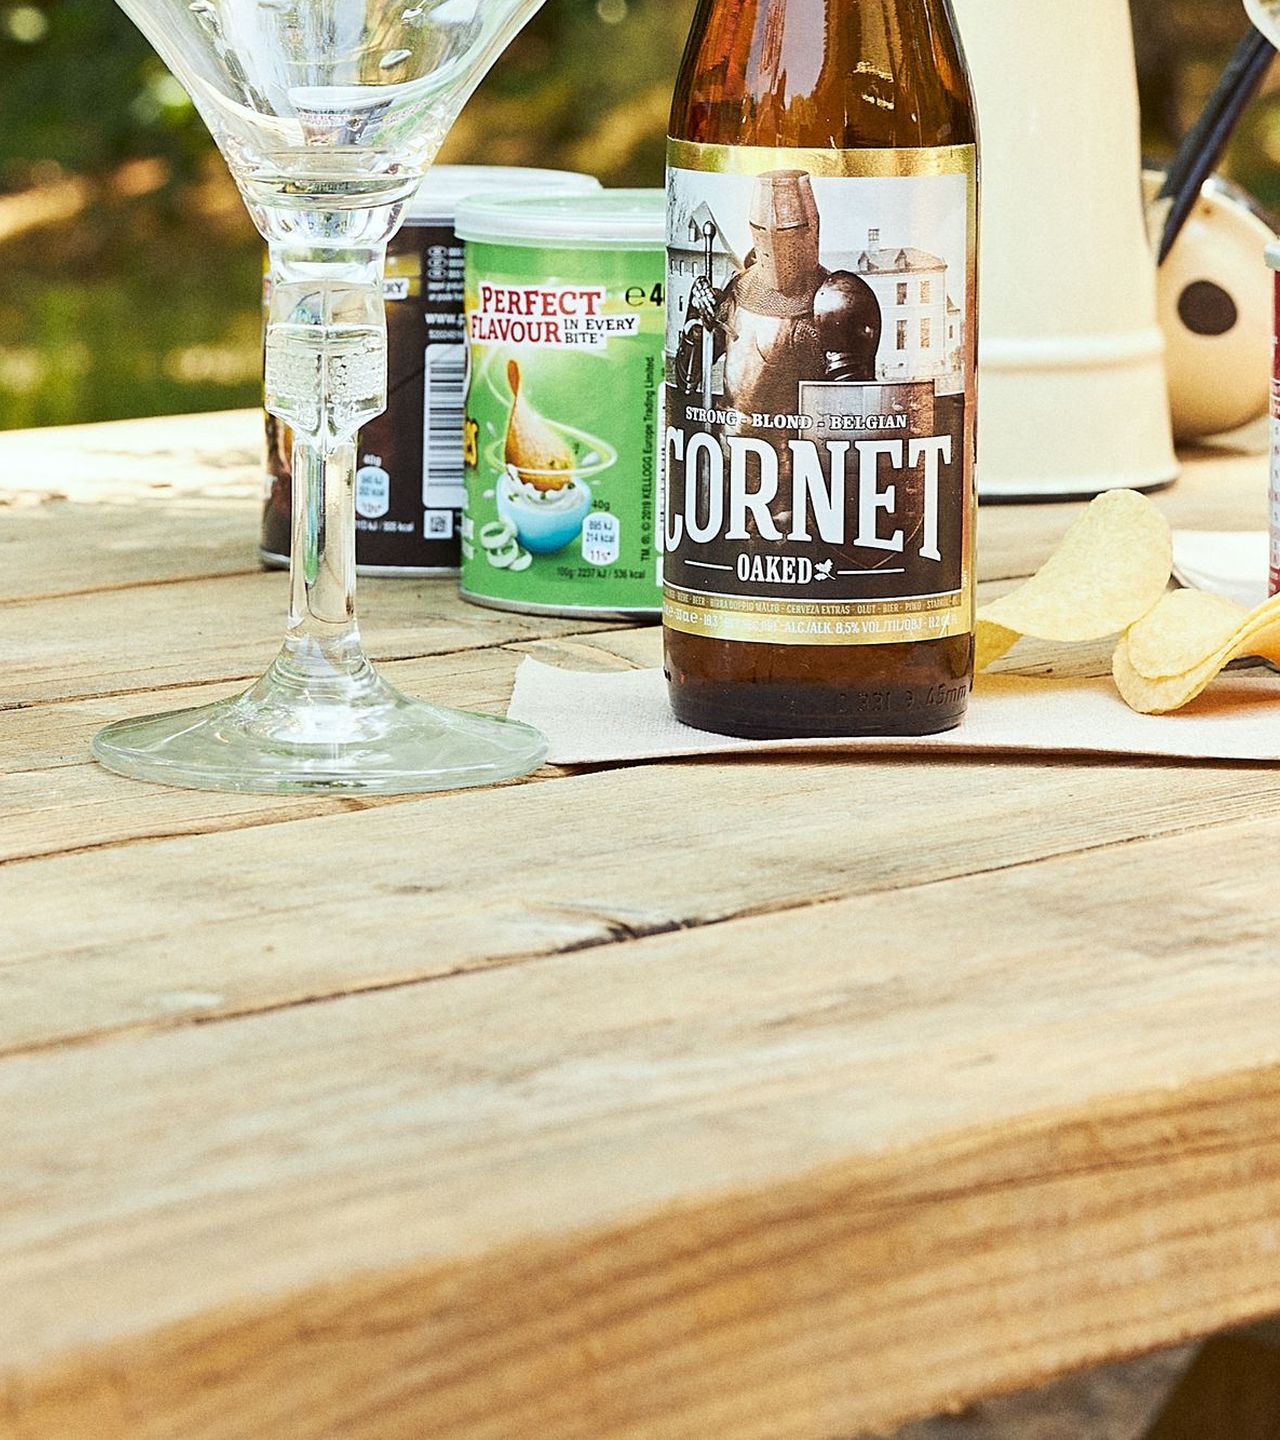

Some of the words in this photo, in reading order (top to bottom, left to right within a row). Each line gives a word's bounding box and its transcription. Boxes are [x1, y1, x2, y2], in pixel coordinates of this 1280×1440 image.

[481, 286, 602, 316] PERFECT
[471, 315, 561, 343] FLAVOUR
[564, 318, 579, 330] IN
[586, 317, 635, 331] EVERY
[643, 389, 654, 423] Trading
[685, 405, 737, 426] STRONG
[752, 414, 813, 429] BLOND
[829, 413, 908, 431] BELGIAN
[642, 423, 653, 459] Europe
[641, 459, 652, 500] KELLOGG
[665, 424, 951, 562] CORNET
[592, 499, 611, 511] 40g
[641, 500, 652, 519] 2019
[585, 532, 600, 542] 214
[600, 532, 615, 543] kcal
[629, 569, 646, 580] kcal
[737, 553, 813, 585] OAKED
[786, 603, 821, 616] CERVEZA
[821, 604, 850, 615] EXTRAS
[857, 604, 876, 614] OLUT
